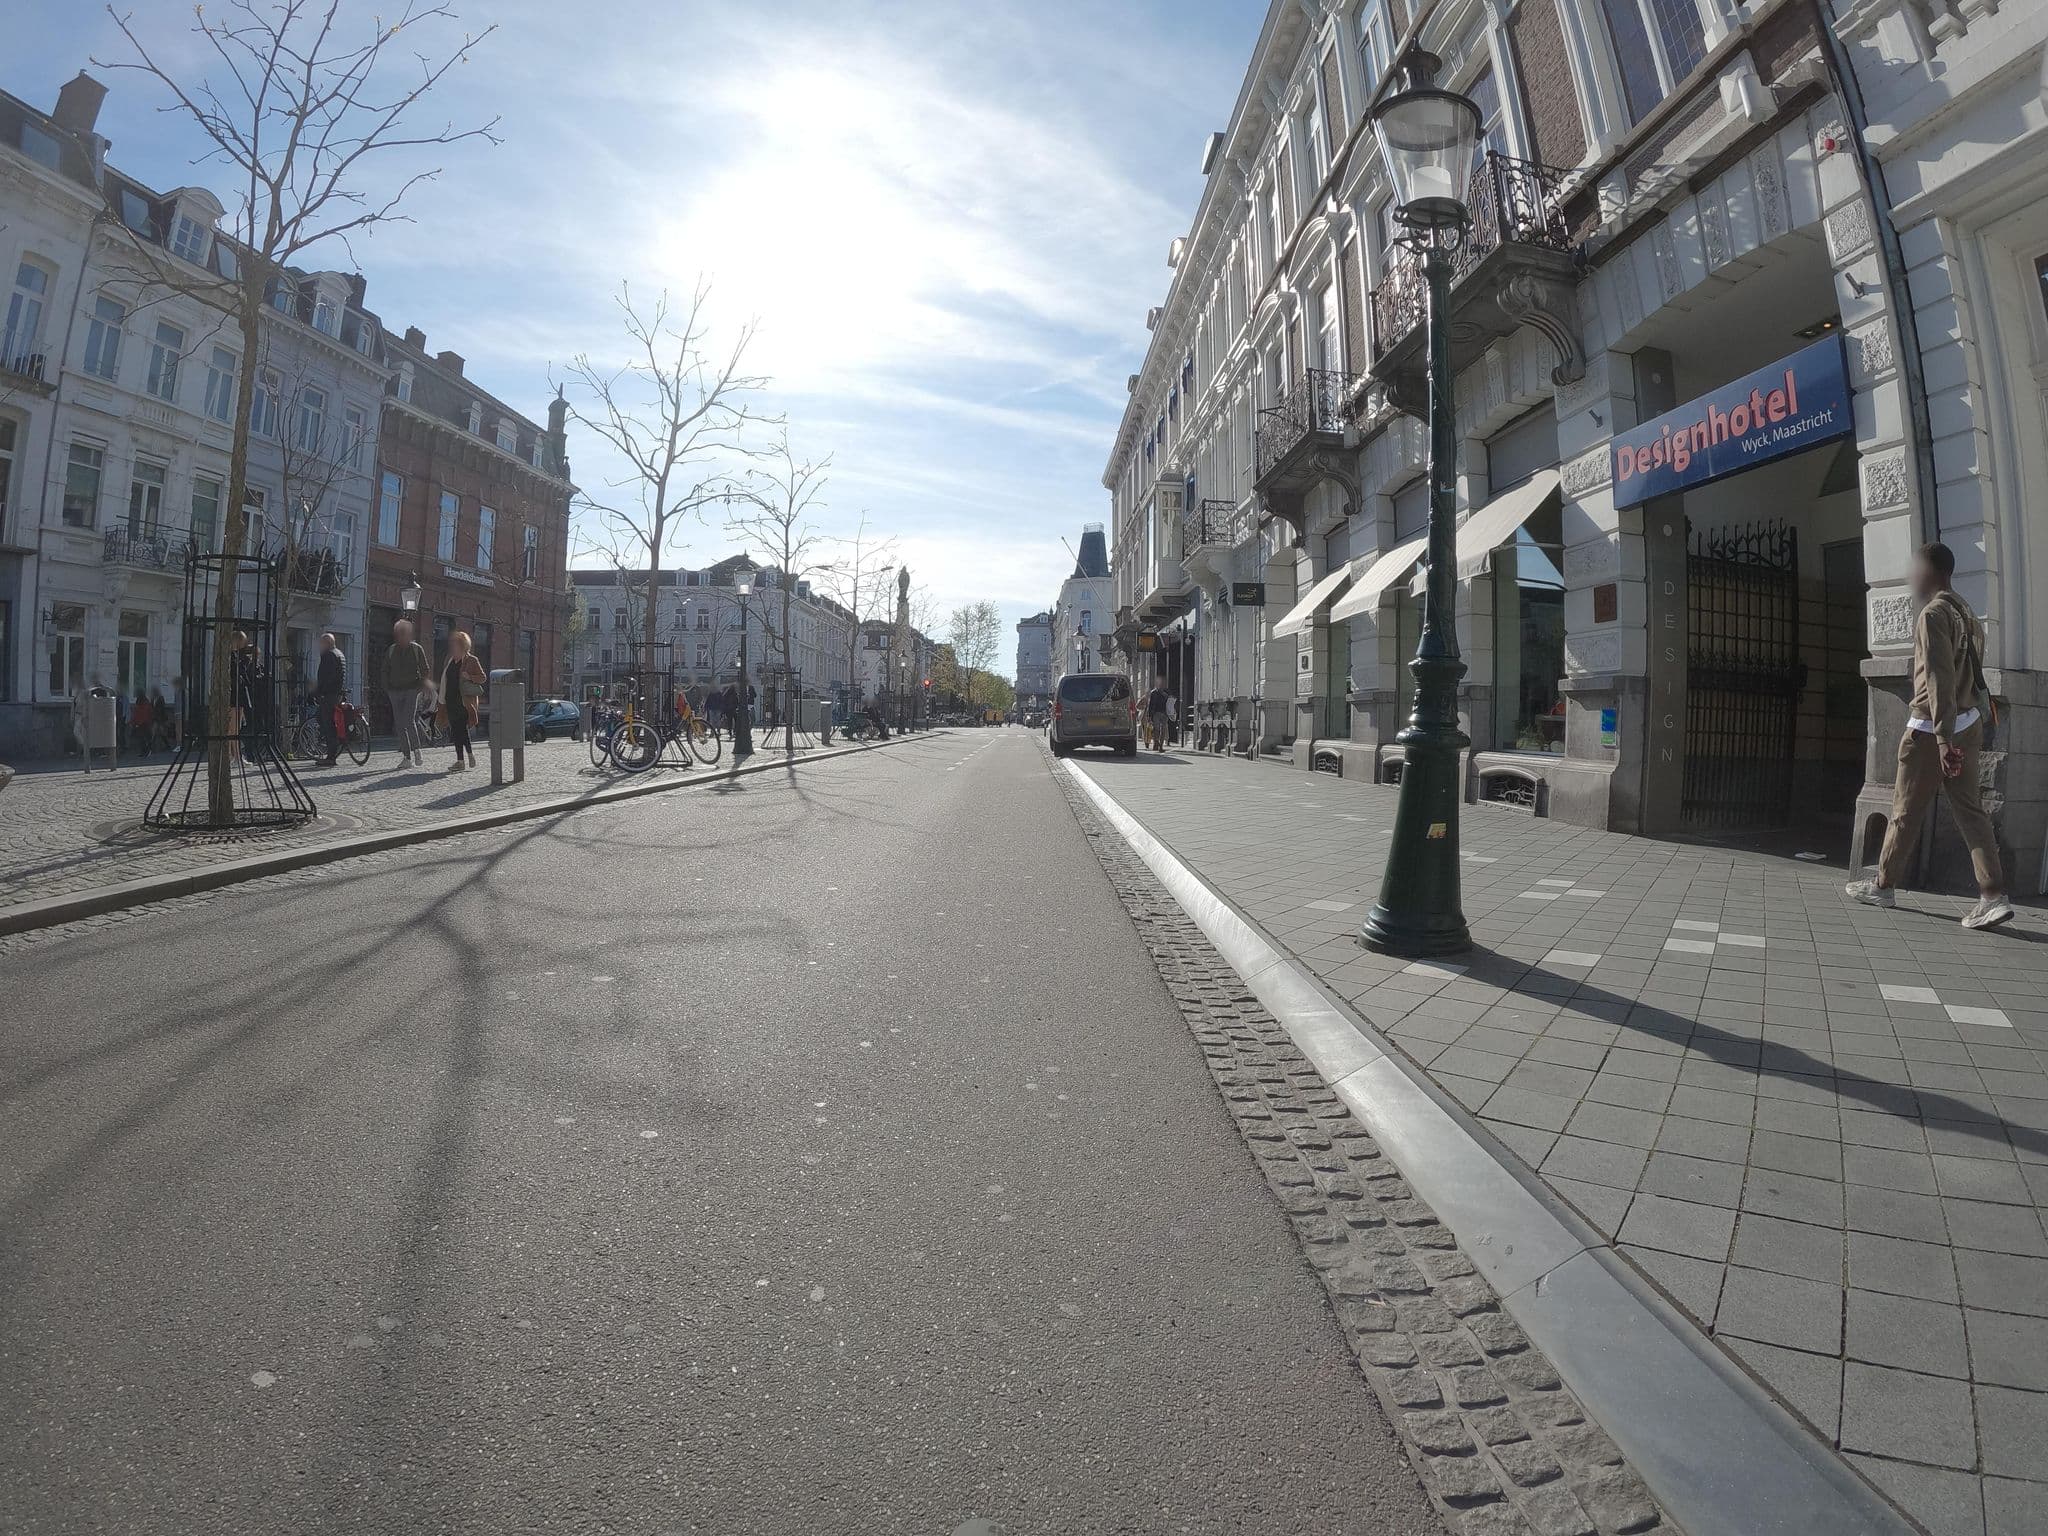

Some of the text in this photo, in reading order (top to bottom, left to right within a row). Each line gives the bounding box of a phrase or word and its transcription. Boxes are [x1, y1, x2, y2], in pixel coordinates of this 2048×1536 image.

[1616, 368, 1798, 481] Designhotel
[1741, 408, 1833, 454] Wyck, Maastricht
[1662, 580, 1676, 762] DESIGN
